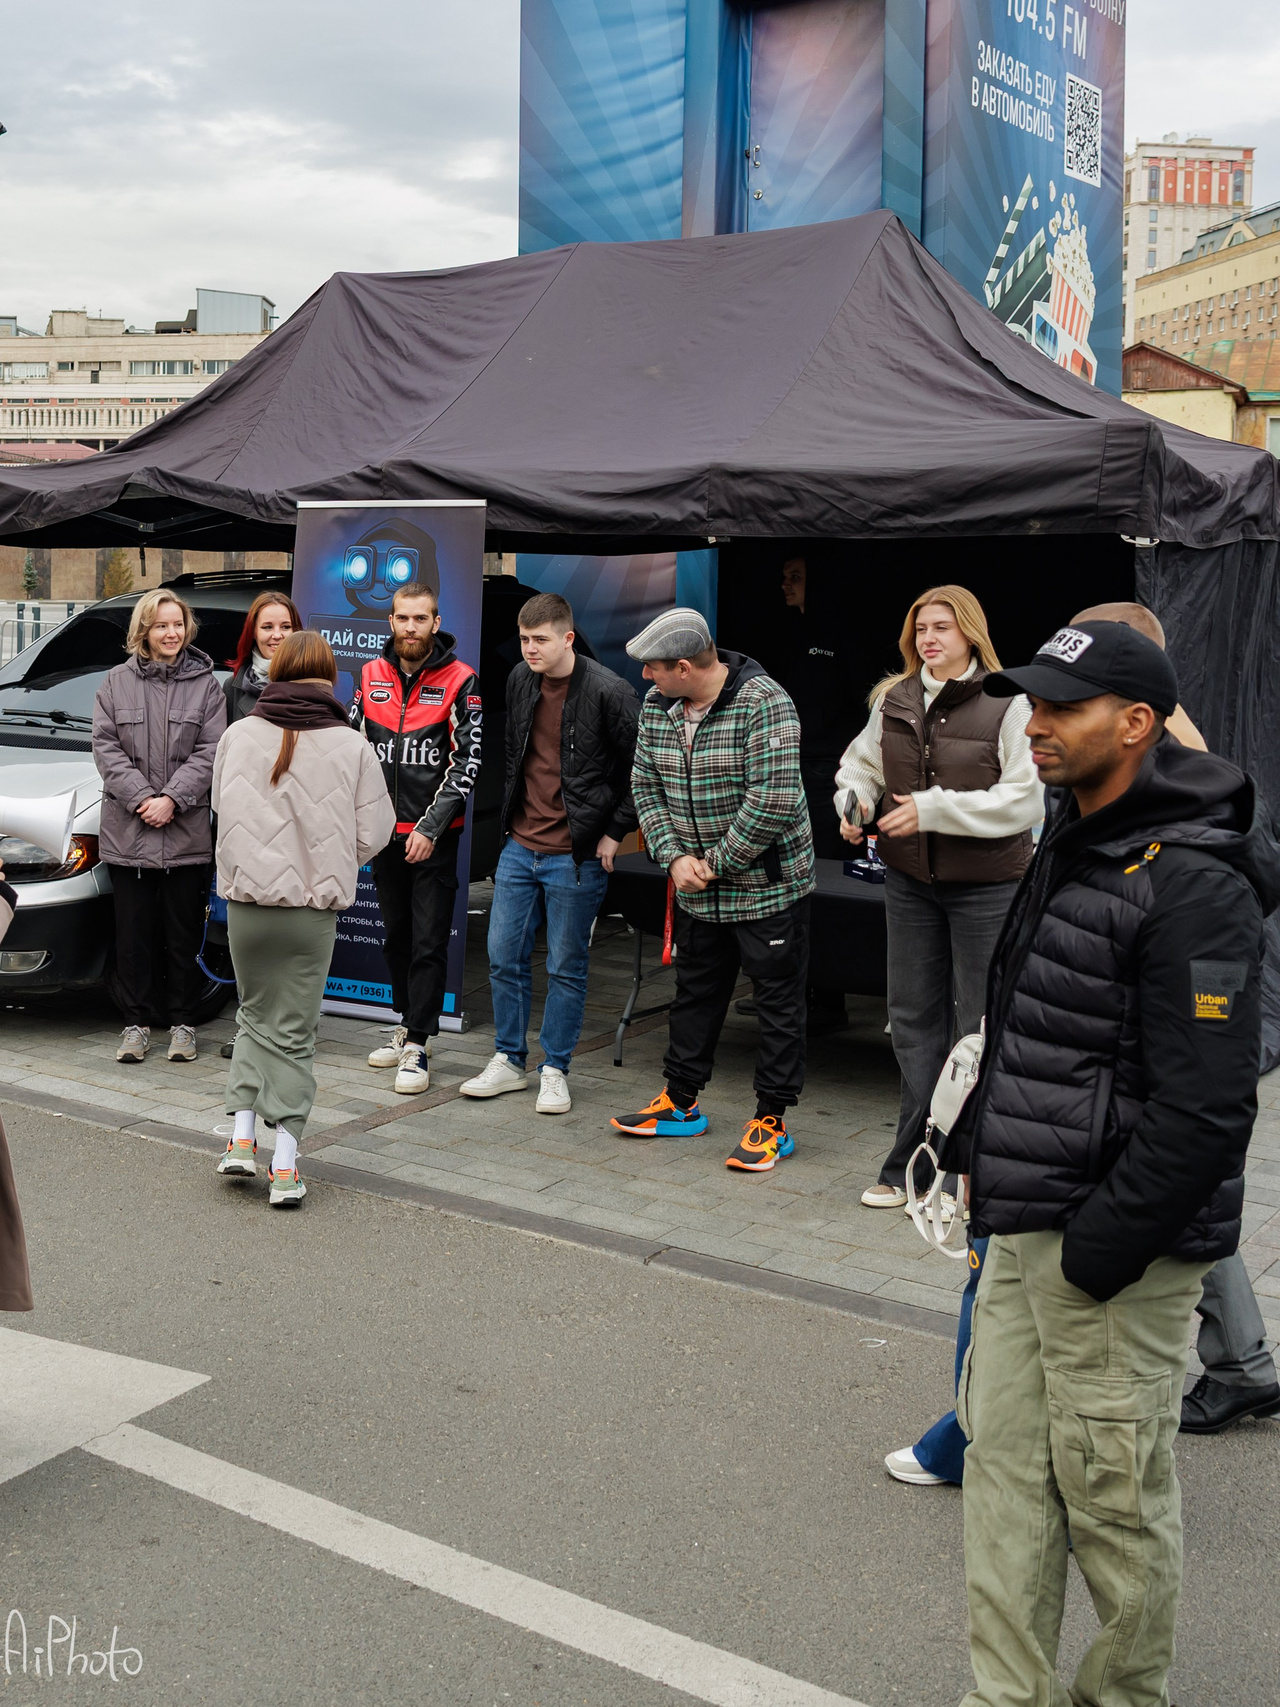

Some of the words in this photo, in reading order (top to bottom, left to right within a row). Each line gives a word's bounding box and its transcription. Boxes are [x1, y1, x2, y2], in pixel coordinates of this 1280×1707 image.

[1062, 4, 1087, 60] FM
[978, 40, 1032, 95] ЗАКАЗАТЬ
[1035, 70, 1056, 109] ЕДУ
[971, 75, 980, 107] В
[981, 82, 1055, 142] АВТОМОБИЛЬ
[320, 628, 353, 647] ДАЙ
[357, 633, 391, 650] СВЕ
[331, 649, 354, 658] ЕРСКАЯ
[400, 737, 440, 766] life
[451, 711, 483, 800] Society
[354, 900, 380, 909] АНТИХ
[341, 916, 374, 927] СТРОБЫ,
[335, 932, 352, 942] ЙКА,
[353, 935, 380, 946] БРОНЬ,
[346, 984, 358, 994] +7
[360, 984, 385, 999] (936)
[1195, 993, 1228, 1005] Urban
